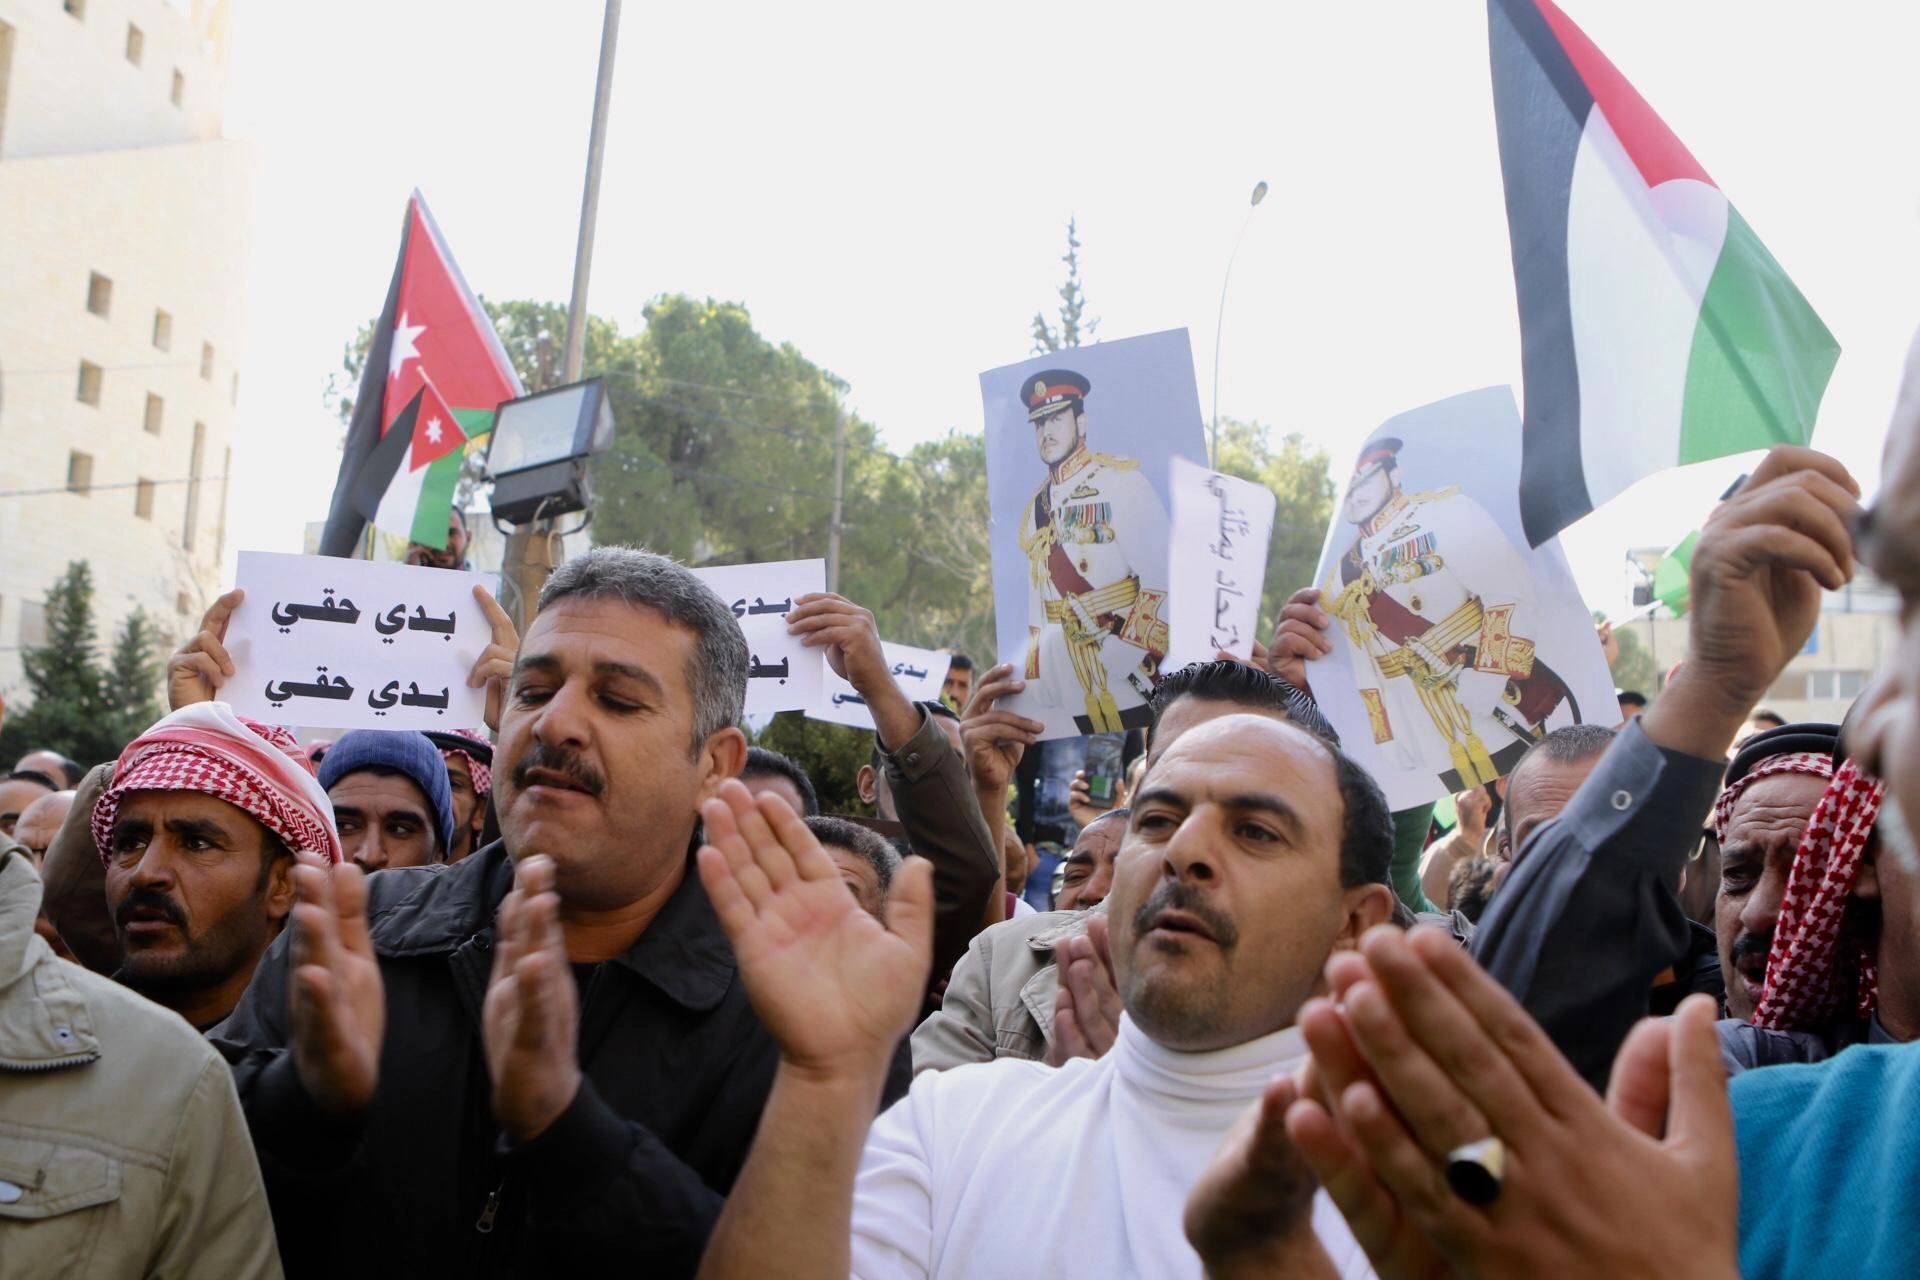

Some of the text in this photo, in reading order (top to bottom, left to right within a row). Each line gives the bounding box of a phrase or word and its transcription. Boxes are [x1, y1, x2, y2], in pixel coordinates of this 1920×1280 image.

[271, 587, 456, 645] بدي حقي
[264, 665, 450, 717] بدي حقي
[748, 653, 789, 686] بد
